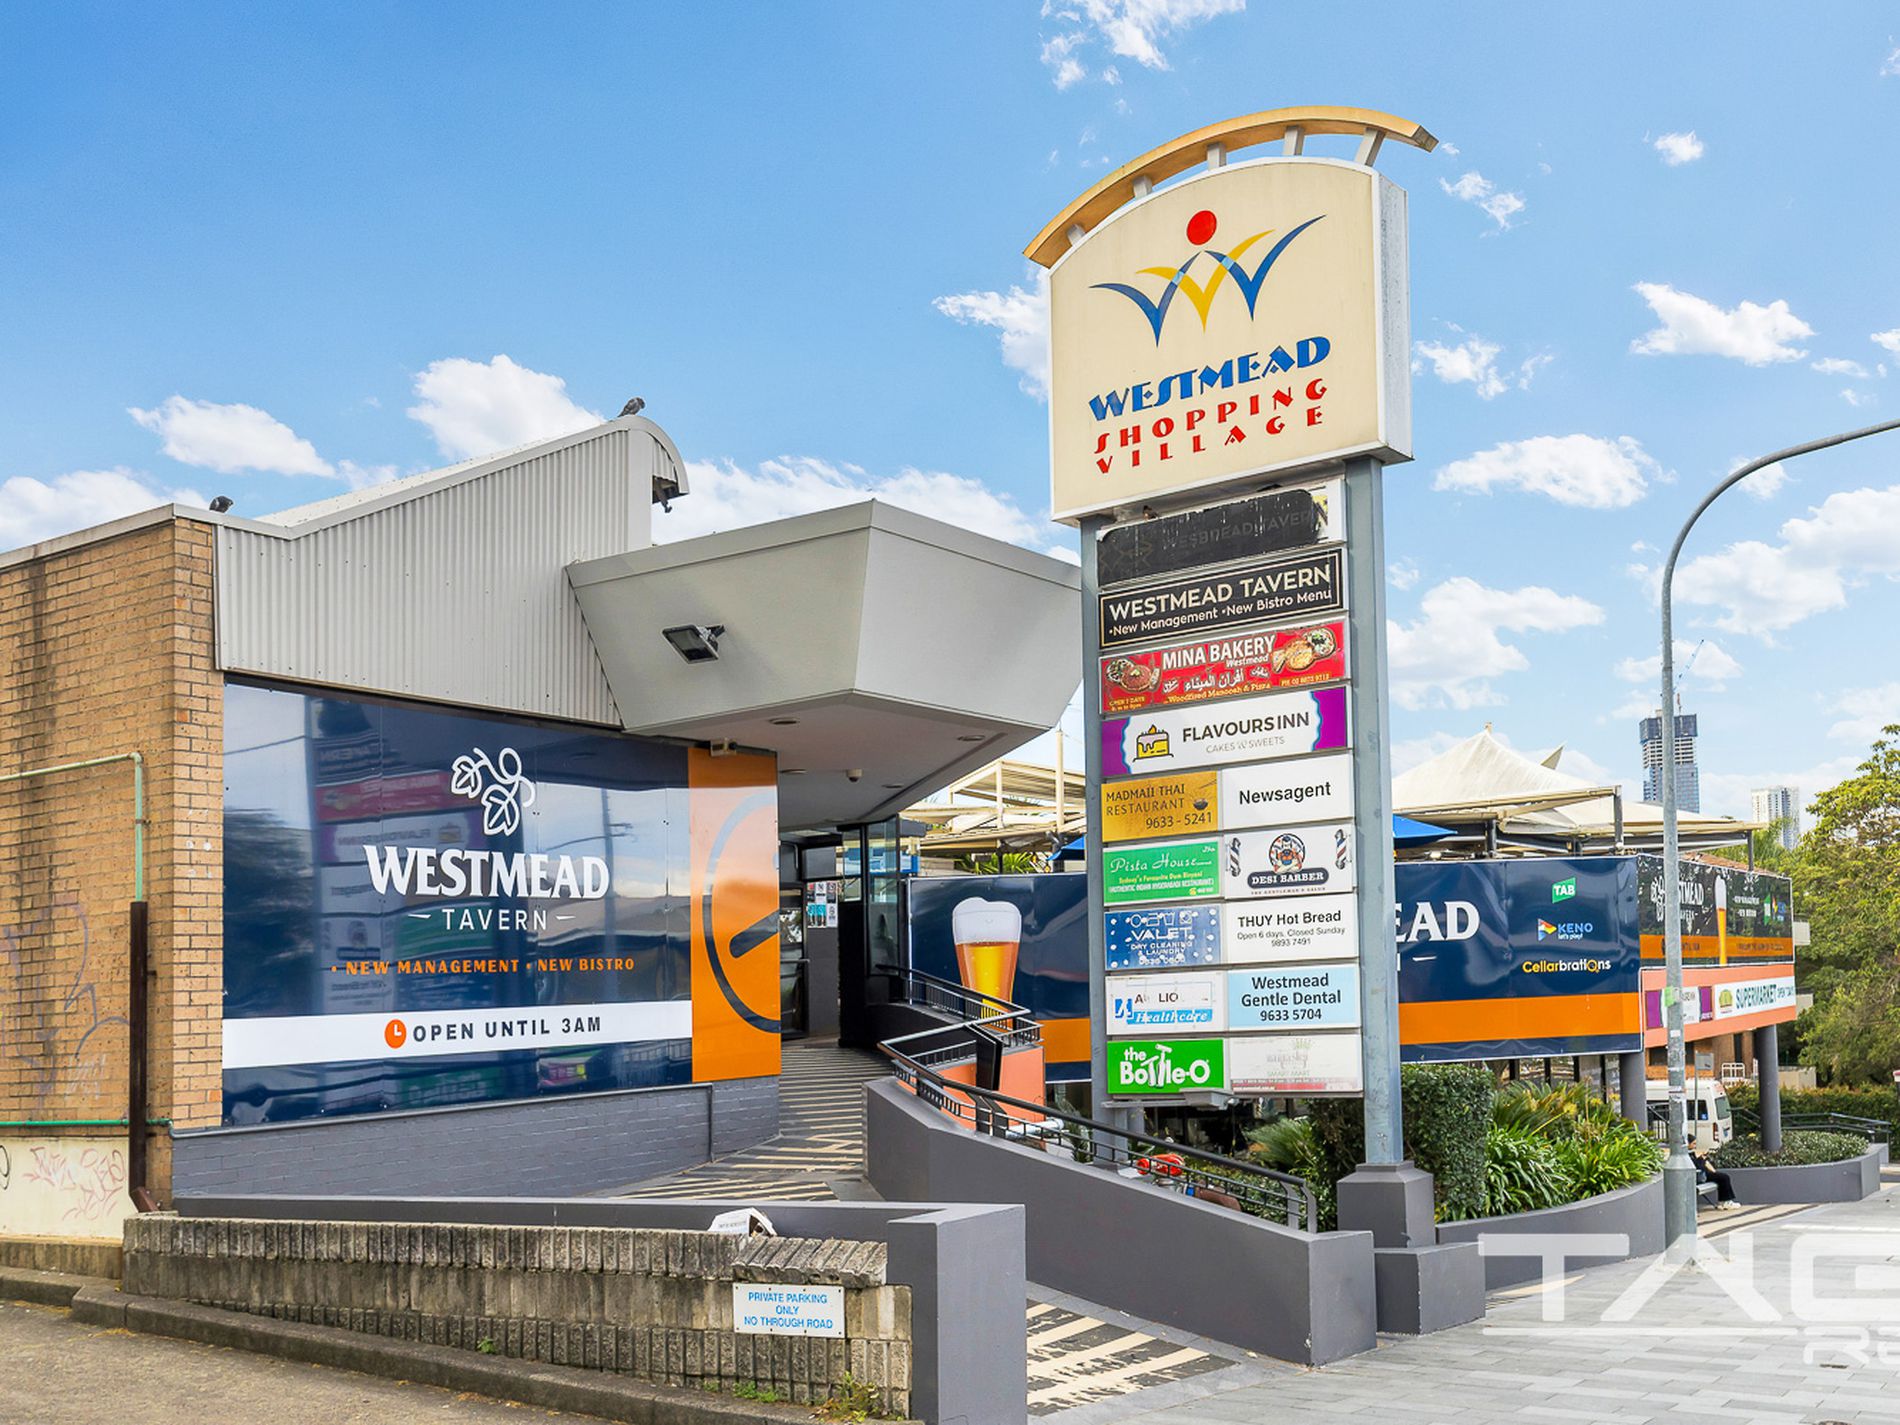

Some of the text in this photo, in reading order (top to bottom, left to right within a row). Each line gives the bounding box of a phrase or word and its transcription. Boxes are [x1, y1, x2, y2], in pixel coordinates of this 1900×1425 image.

[1088, 336, 1331, 421] WESTMEAD
[1094, 378, 1328, 454] SHOPPING
[1096, 405, 1322, 474] VILLAGE
[1109, 564, 1331, 621] WESTMEAD TAVERN
[1140, 607, 1218, 631] Management
[1257, 596, 1293, 611] Bistro
[1296, 588, 1332, 605] Menu
[1162, 634, 1276, 670] MINA BAKERY
[1226, 654, 1269, 668] Westmead
[1182, 712, 1310, 743] FLAVOURS INN
[1206, 741, 1236, 754] CAKES
[1248, 736, 1286, 749] SWEETS
[1158, 783, 1185, 796] THAI
[1239, 781, 1331, 805] Newsagent
[1106, 798, 1185, 816] RESTAURANT
[1146, 816, 1174, 829] 9633
[1184, 812, 1212, 826] 5241
[362, 844, 610, 899] WESTMEAD
[1110, 853, 1212, 873] Pista House
[1252, 872, 1324, 885] DESI BARBER
[1554, 885, 1575, 896] TAB
[442, 908, 548, 931] TAVERN
[1238, 910, 1341, 927] THUY Hot Bread
[1131, 926, 1193, 941] VALET
[1237, 932, 1257, 940] Open
[1287, 928, 1314, 937] Closed
[1316, 927, 1345, 936] Sunday
[1558, 923, 1593, 934] KENO
[1150, 941, 1193, 949] CLEANING
[346, 958, 635, 975] NEW MANAGEMENT NEW BISTRO
[1252, 973, 1329, 990] Westmead
[1241, 990, 1342, 1008] Gentle Dental
[1736, 984, 1777, 1009] SUPERMARKET
[1260, 1008, 1322, 1022] 9633 5704
[413, 1016, 601, 1043] OPEN UNTIL 3AM
[1124, 1047, 1147, 1061] the
[748, 1292, 828, 1304] PRIVATE PARKING
[775, 1305, 799, 1315] ONLY
[744, 1316, 833, 1329] NO THROUGH ROAD
